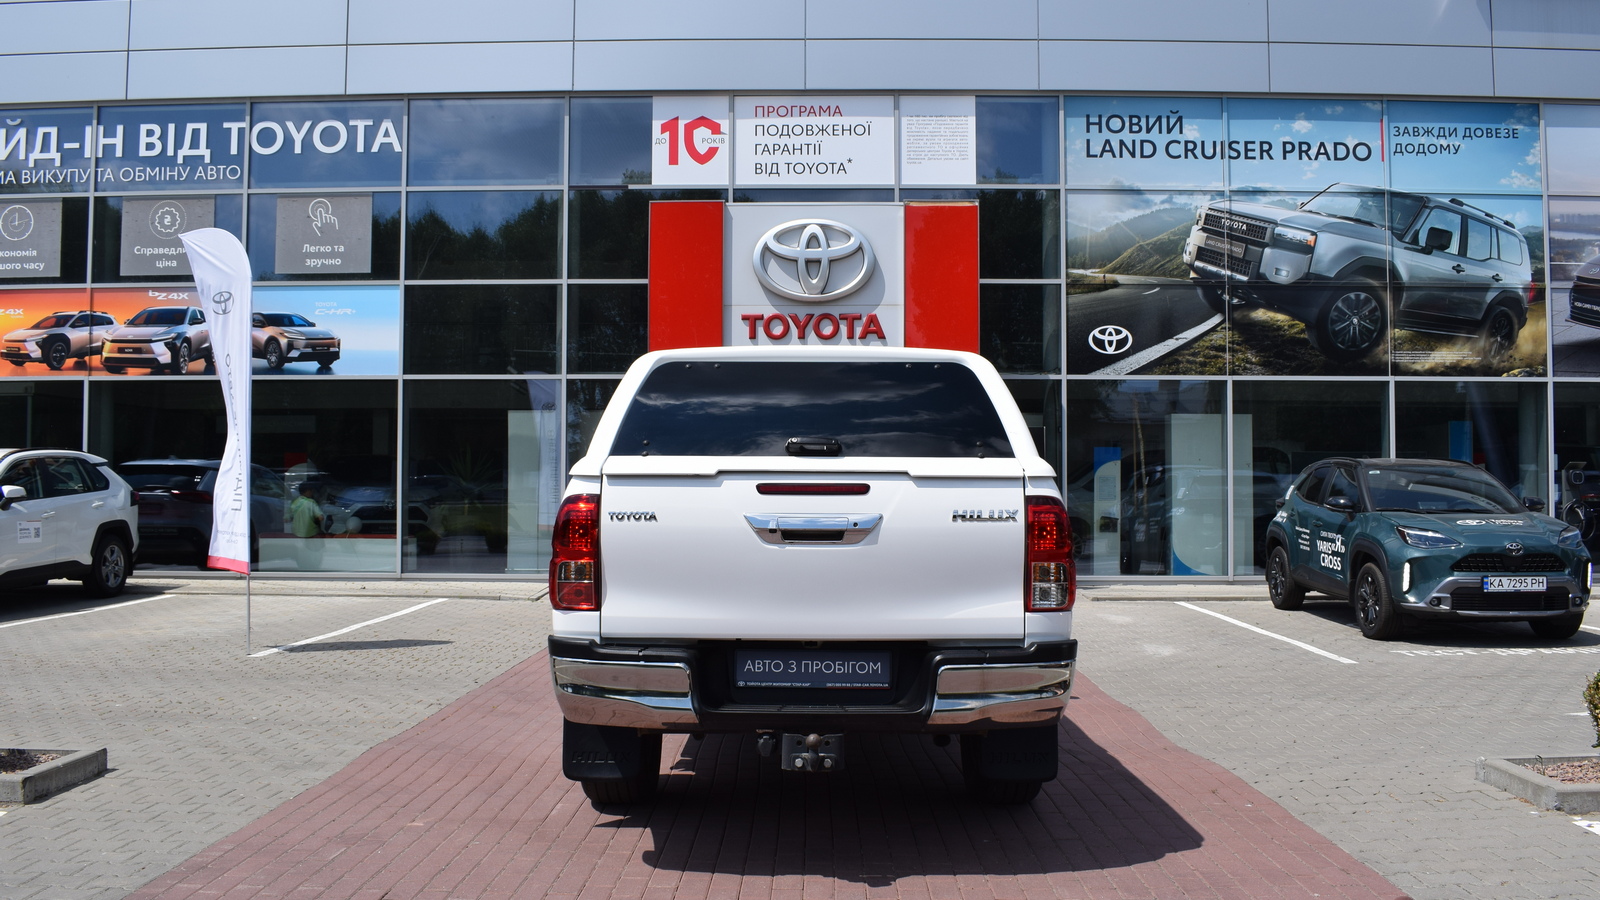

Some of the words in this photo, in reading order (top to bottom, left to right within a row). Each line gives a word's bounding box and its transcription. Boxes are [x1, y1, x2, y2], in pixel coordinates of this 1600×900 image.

[755, 105, 843, 118] ПРОГРАМА
[1085, 109, 1184, 135] НОВИЙ
[755, 121, 872, 139] ПОДОВЖЕНОЇ
[1392, 125, 1458, 141] ЗАВЖДИ
[1461, 127, 1519, 141] ДОВЕЗЕ
[138, 122, 211, 164] ВІД
[223, 118, 403, 155] TOYOTA
[654, 137, 667, 146] ДО
[701, 137, 726, 145] РОКІВ
[755, 141, 823, 156] ГАРАНТІЇ
[1086, 138, 1157, 159] LAND
[1164, 139, 1275, 161] CRUISER
[1282, 141, 1372, 162] PRADO
[1392, 143, 1462, 157] ДОДОМУ
[21, 168, 91, 184] ВИКУПУ
[97, 168, 115, 182] ТА
[120, 165, 191, 182] ОБМІНУ
[194, 165, 241, 181] АВТО
[755, 162, 780, 177] ВІД
[1222, 219, 1247, 231] TOYOTA
[302, 244, 332, 253] Легко
[23, 261, 45, 271] часу
[156, 259, 177, 268] ціна
[305, 258, 342, 268] зручно
[741, 312, 887, 340] TOYOTA
[608, 510, 659, 523] TOYOTA
[952, 509, 1019, 523] HILUX
[1316, 539, 1332, 555] YARIS
[1320, 553, 1342, 571] CROSS
[1489, 578, 1505, 589] KA
[1506, 578, 1529, 589] 7295
[1530, 578, 1545, 589] PH
[743, 659, 784, 673] АВТО
[787, 660, 797, 673] З
[801, 660, 881, 674] ПРОБІГОМ
